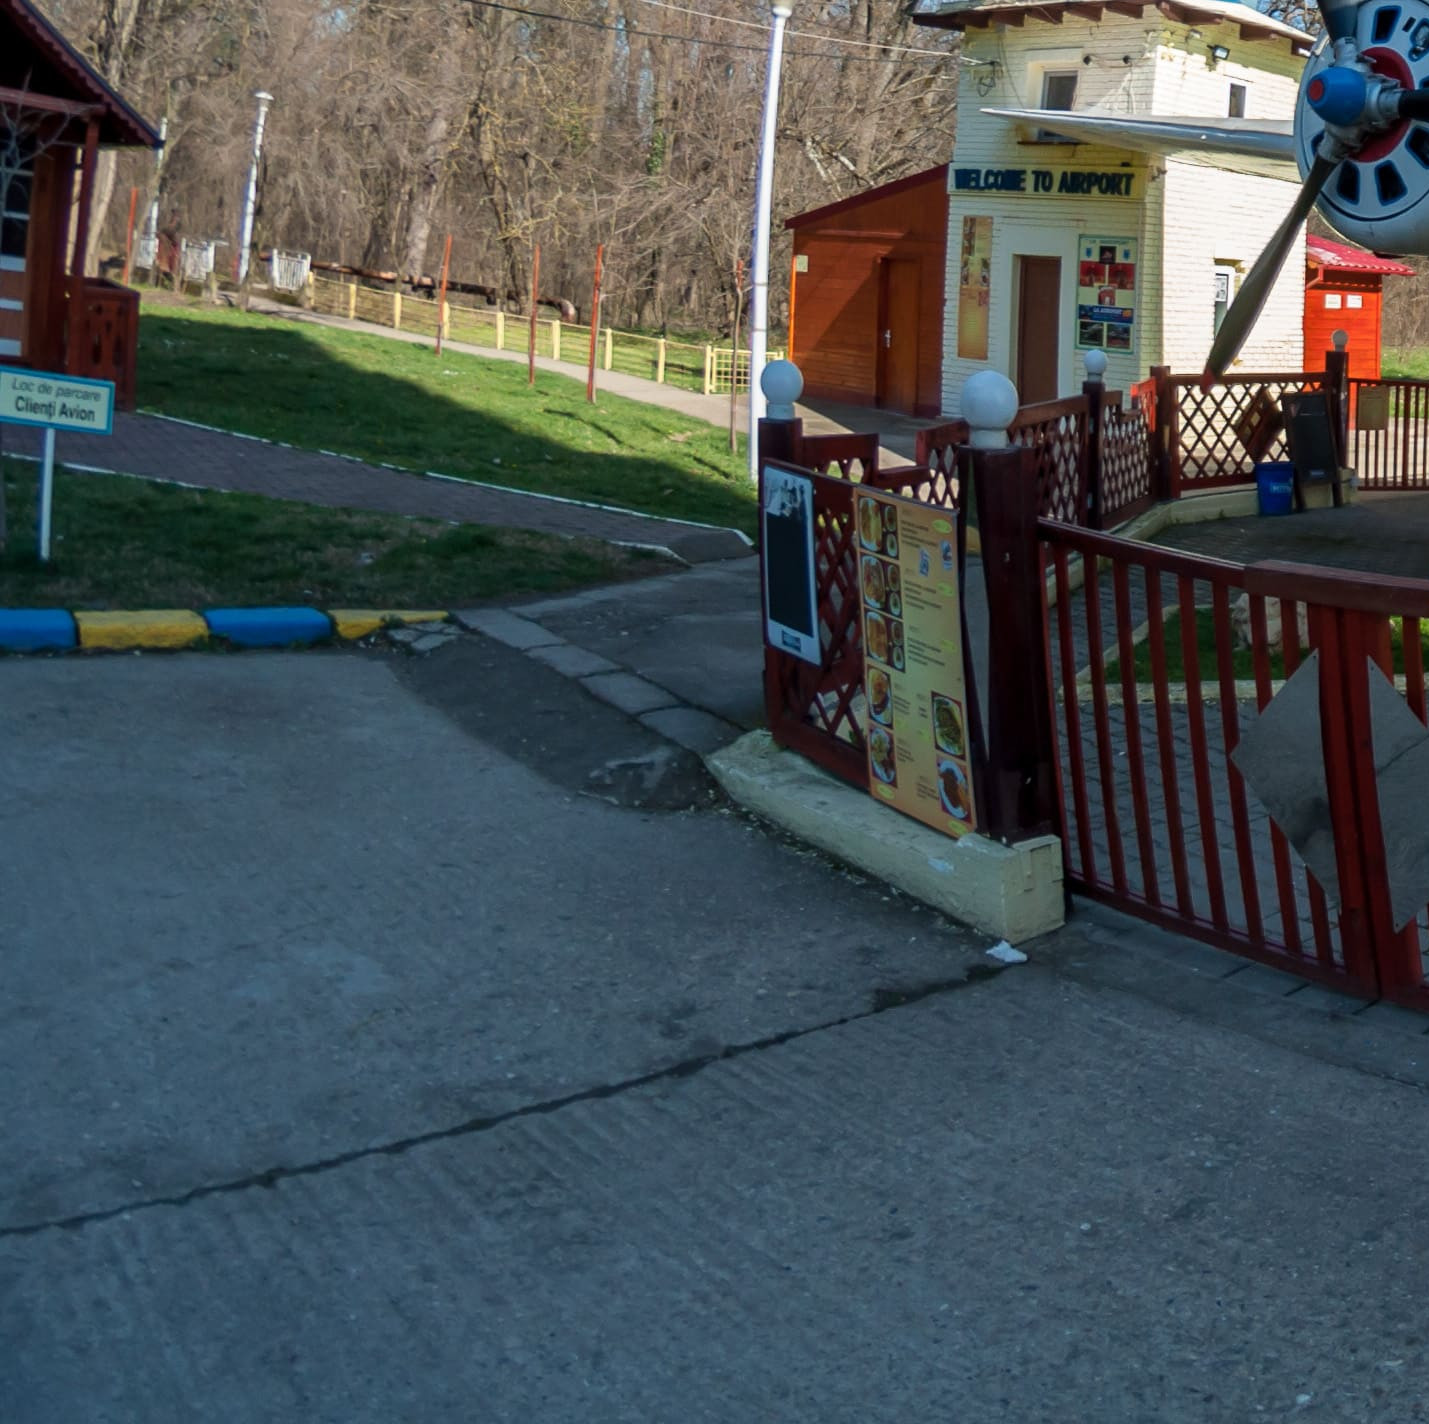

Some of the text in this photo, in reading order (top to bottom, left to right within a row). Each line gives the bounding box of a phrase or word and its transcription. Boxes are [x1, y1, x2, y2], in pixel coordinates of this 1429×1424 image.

[954, 169, 1135, 196] WELCOME TO AIRPORT
[11, 377, 102, 402] Loc de parcare
[59, 402, 96, 422] Avion
